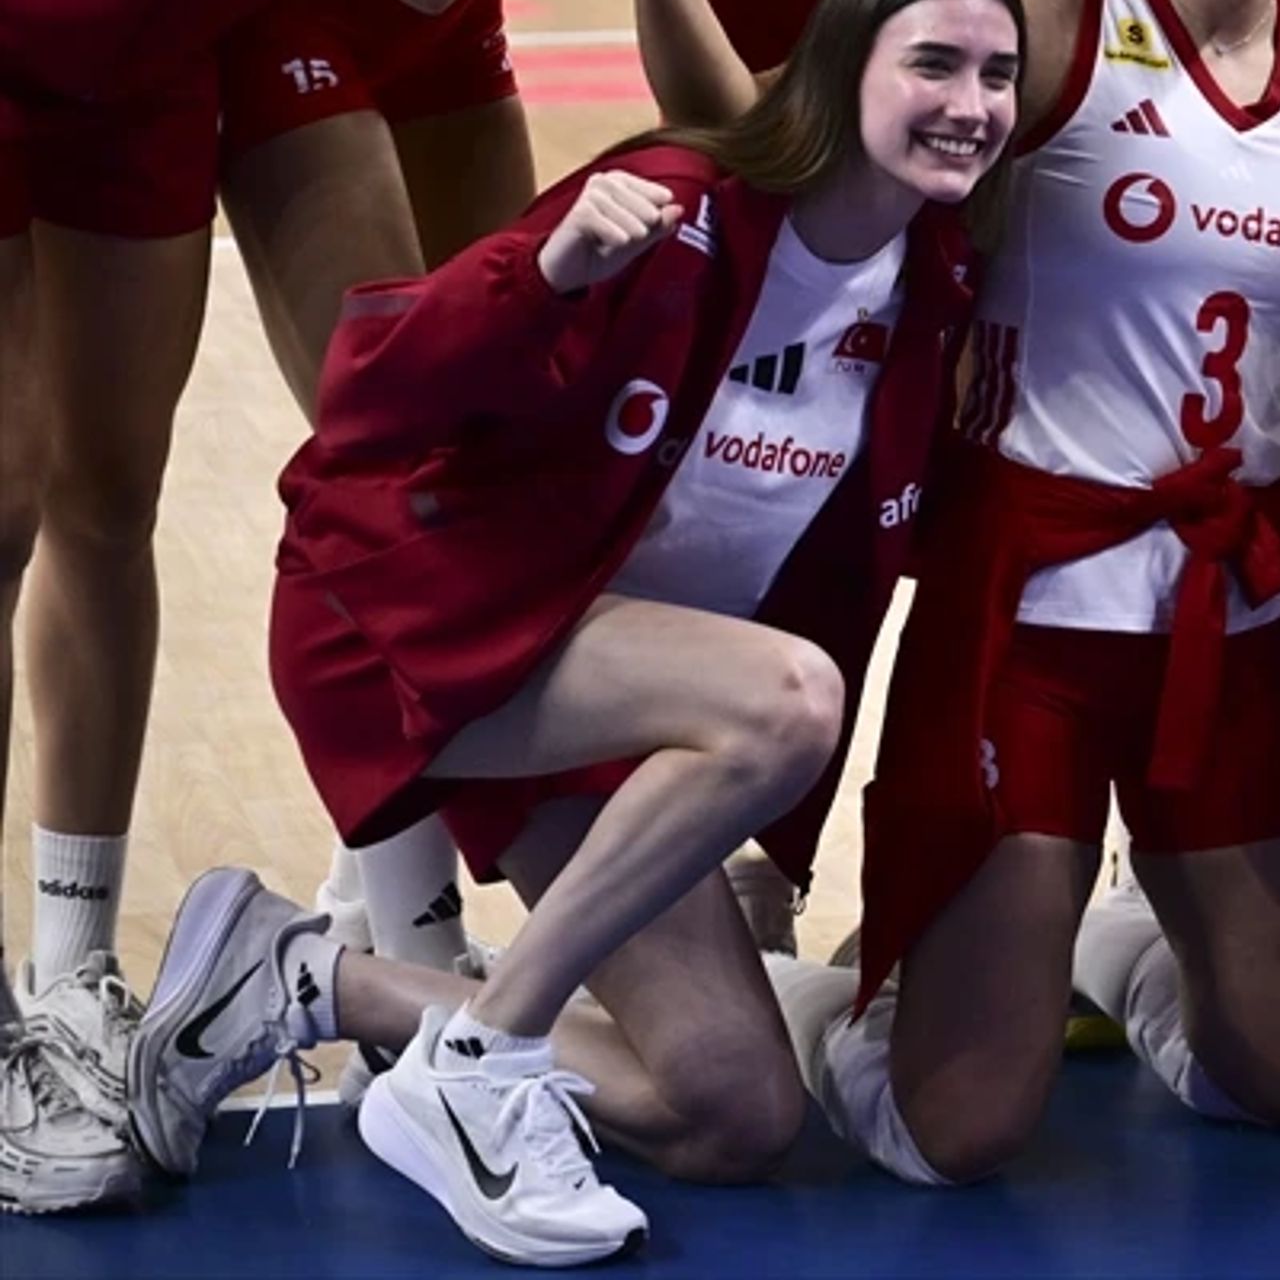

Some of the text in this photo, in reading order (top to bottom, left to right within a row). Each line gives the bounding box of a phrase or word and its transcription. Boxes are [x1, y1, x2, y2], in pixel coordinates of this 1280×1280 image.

[1127, 24, 1144, 45] S
[281, 57, 339, 94] 15
[1180, 290, 1250, 449] 3
[704, 430, 847, 478] vodafone
[37, 878, 110, 901] adidas
